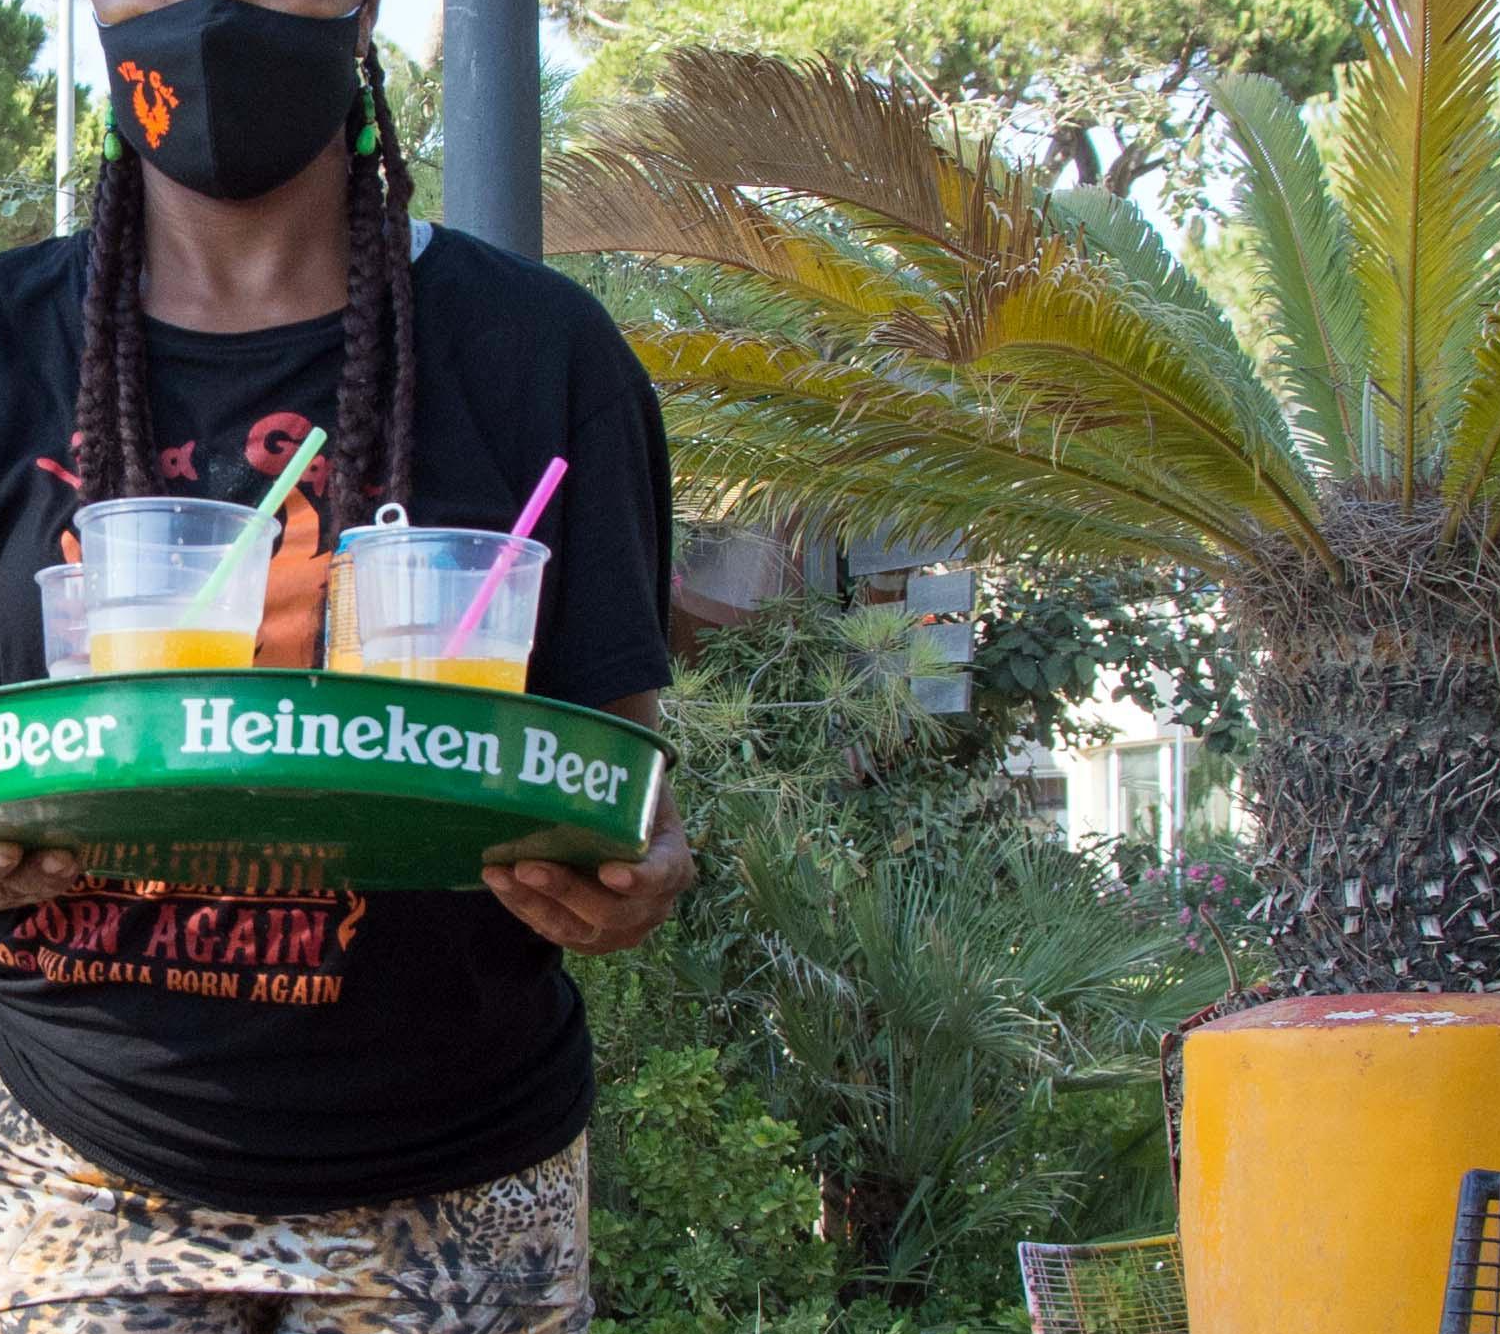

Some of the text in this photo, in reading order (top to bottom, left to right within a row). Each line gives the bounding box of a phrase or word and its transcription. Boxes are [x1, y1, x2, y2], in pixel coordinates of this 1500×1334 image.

[180, 697, 502, 777] Heineken
[517, 725, 629, 805] Beer
[143, 903, 329, 968] AGAIN
[165, 968, 241, 1000] BORN
[249, 973, 345, 1006] AGAIN
